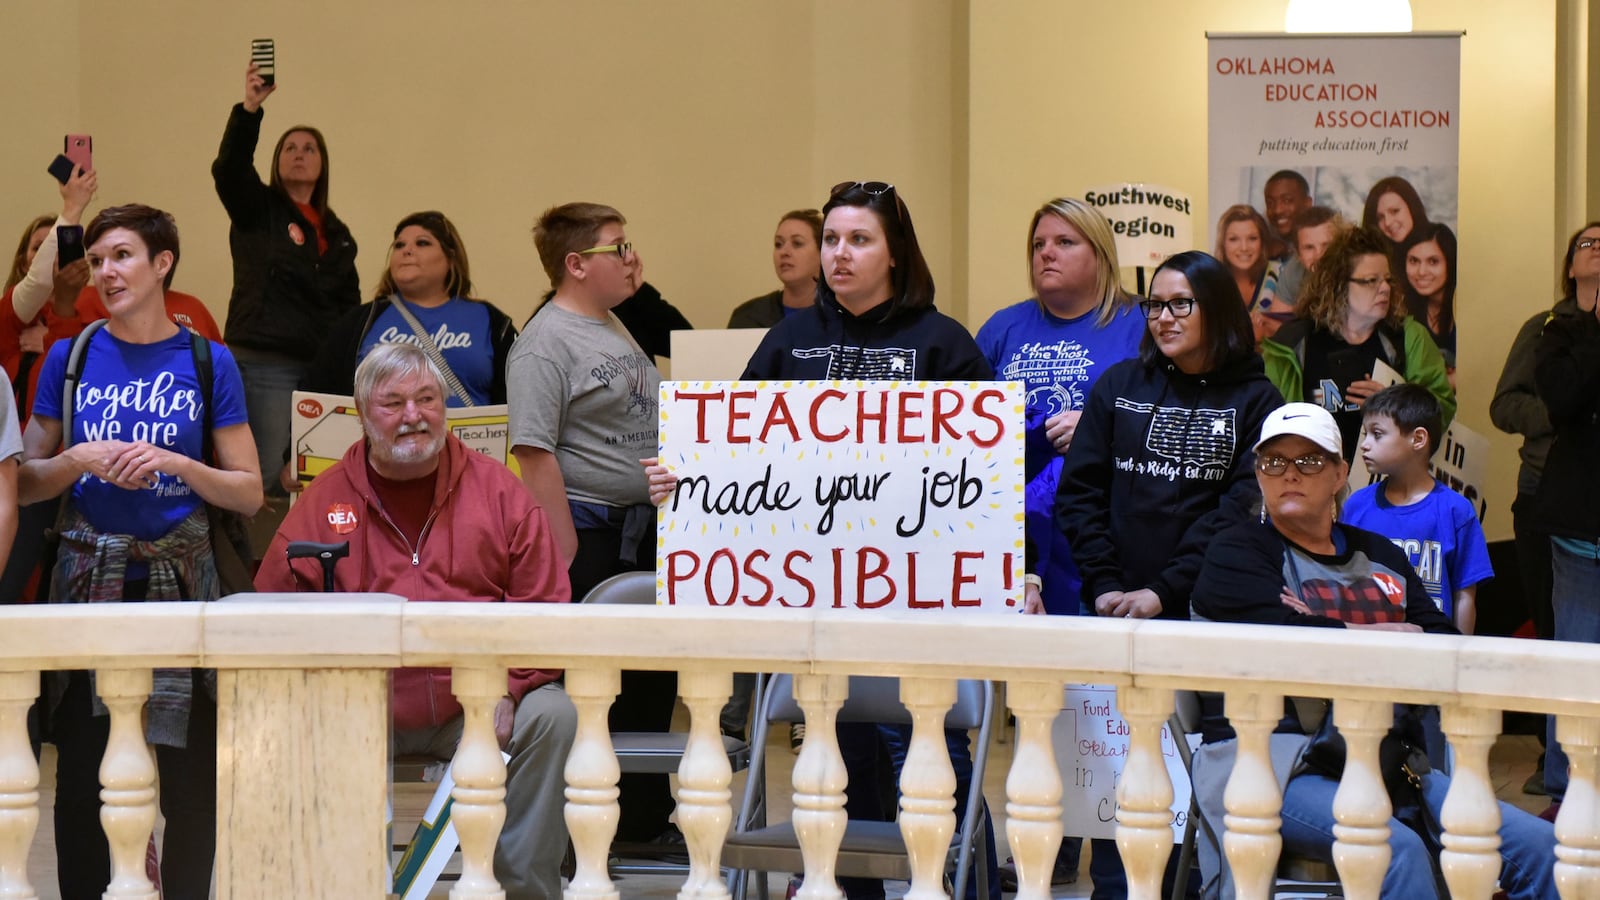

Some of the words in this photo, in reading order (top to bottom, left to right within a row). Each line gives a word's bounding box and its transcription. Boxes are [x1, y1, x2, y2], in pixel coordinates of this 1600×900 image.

[1216, 57, 1335, 75] OKLAHOMA
[1265, 84, 1377, 101] EDUCATION
[1314, 110, 1450, 128] ASSOCIATION
[1259, 138, 1309, 155] putting
[1312, 137, 1376, 151] education
[1378, 137, 1409, 155] first
[1085, 187, 1191, 215] Southwest
[1108, 217, 1175, 238] egion
[1020, 340, 1083, 354] Education
[1029, 351, 1052, 359] the
[1056, 348, 1089, 359] most
[1005, 370, 1049, 380] weapon
[1053, 368, 1087, 376] which
[1077, 373, 1089, 381] to
[76, 371, 203, 421] together
[299, 403, 321, 416] OEA
[674, 388, 1007, 448] TEACHERS
[83, 419, 122, 443] we
[131, 420, 178, 446] are
[1444, 429, 1466, 470] in
[1147, 460, 1180, 481] Ridge
[672, 463, 802, 516] made
[815, 471, 892, 535] your
[896, 456, 984, 538] job
[327, 511, 358, 525] OEA
[665, 546, 1020, 609] POSSIBLE!
[1083, 700, 1110, 717] Fund
[1075, 760, 1093, 788] in
